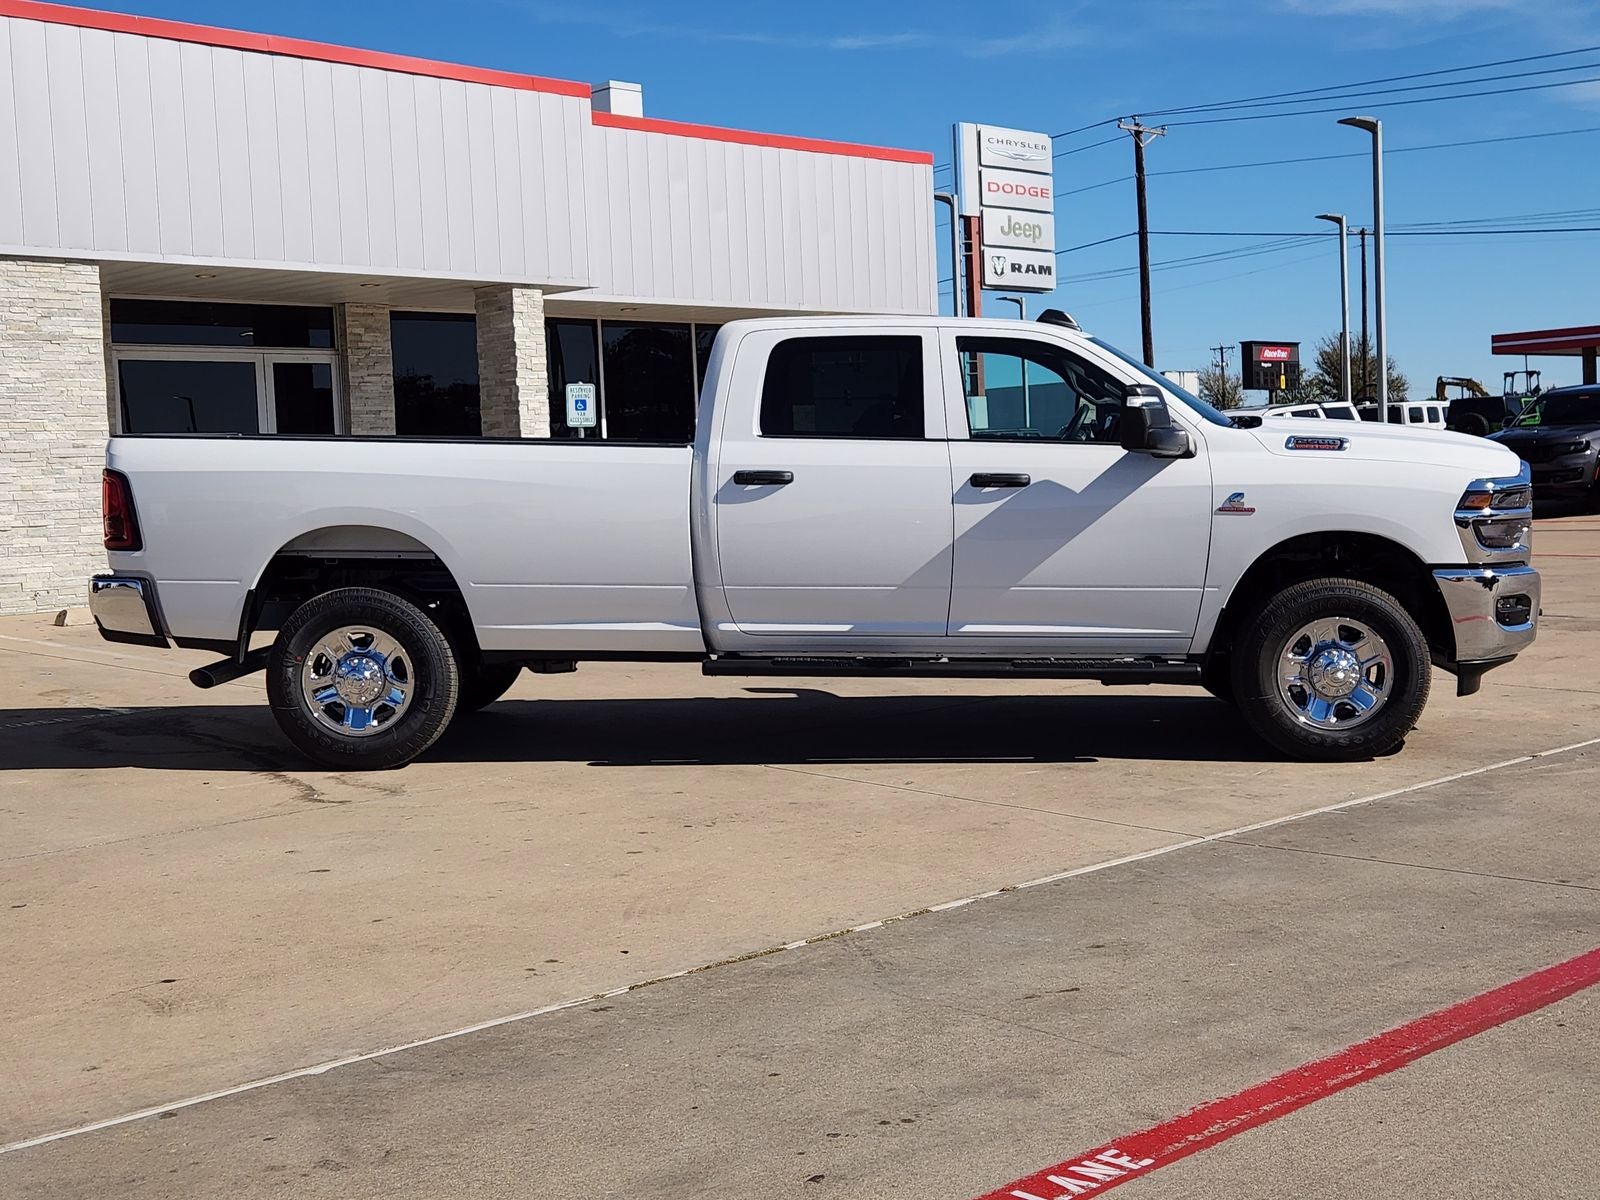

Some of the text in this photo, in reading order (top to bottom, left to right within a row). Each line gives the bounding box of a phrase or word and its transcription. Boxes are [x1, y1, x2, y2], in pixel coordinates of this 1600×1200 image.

[987, 137, 1047, 151] CHRYSLER
[987, 181, 1050, 199] DODGE
[1000, 215, 1042, 243] Jeep
[1010, 262, 1052, 276] RAM
[1010, 1149, 1155, 1200] LANE
